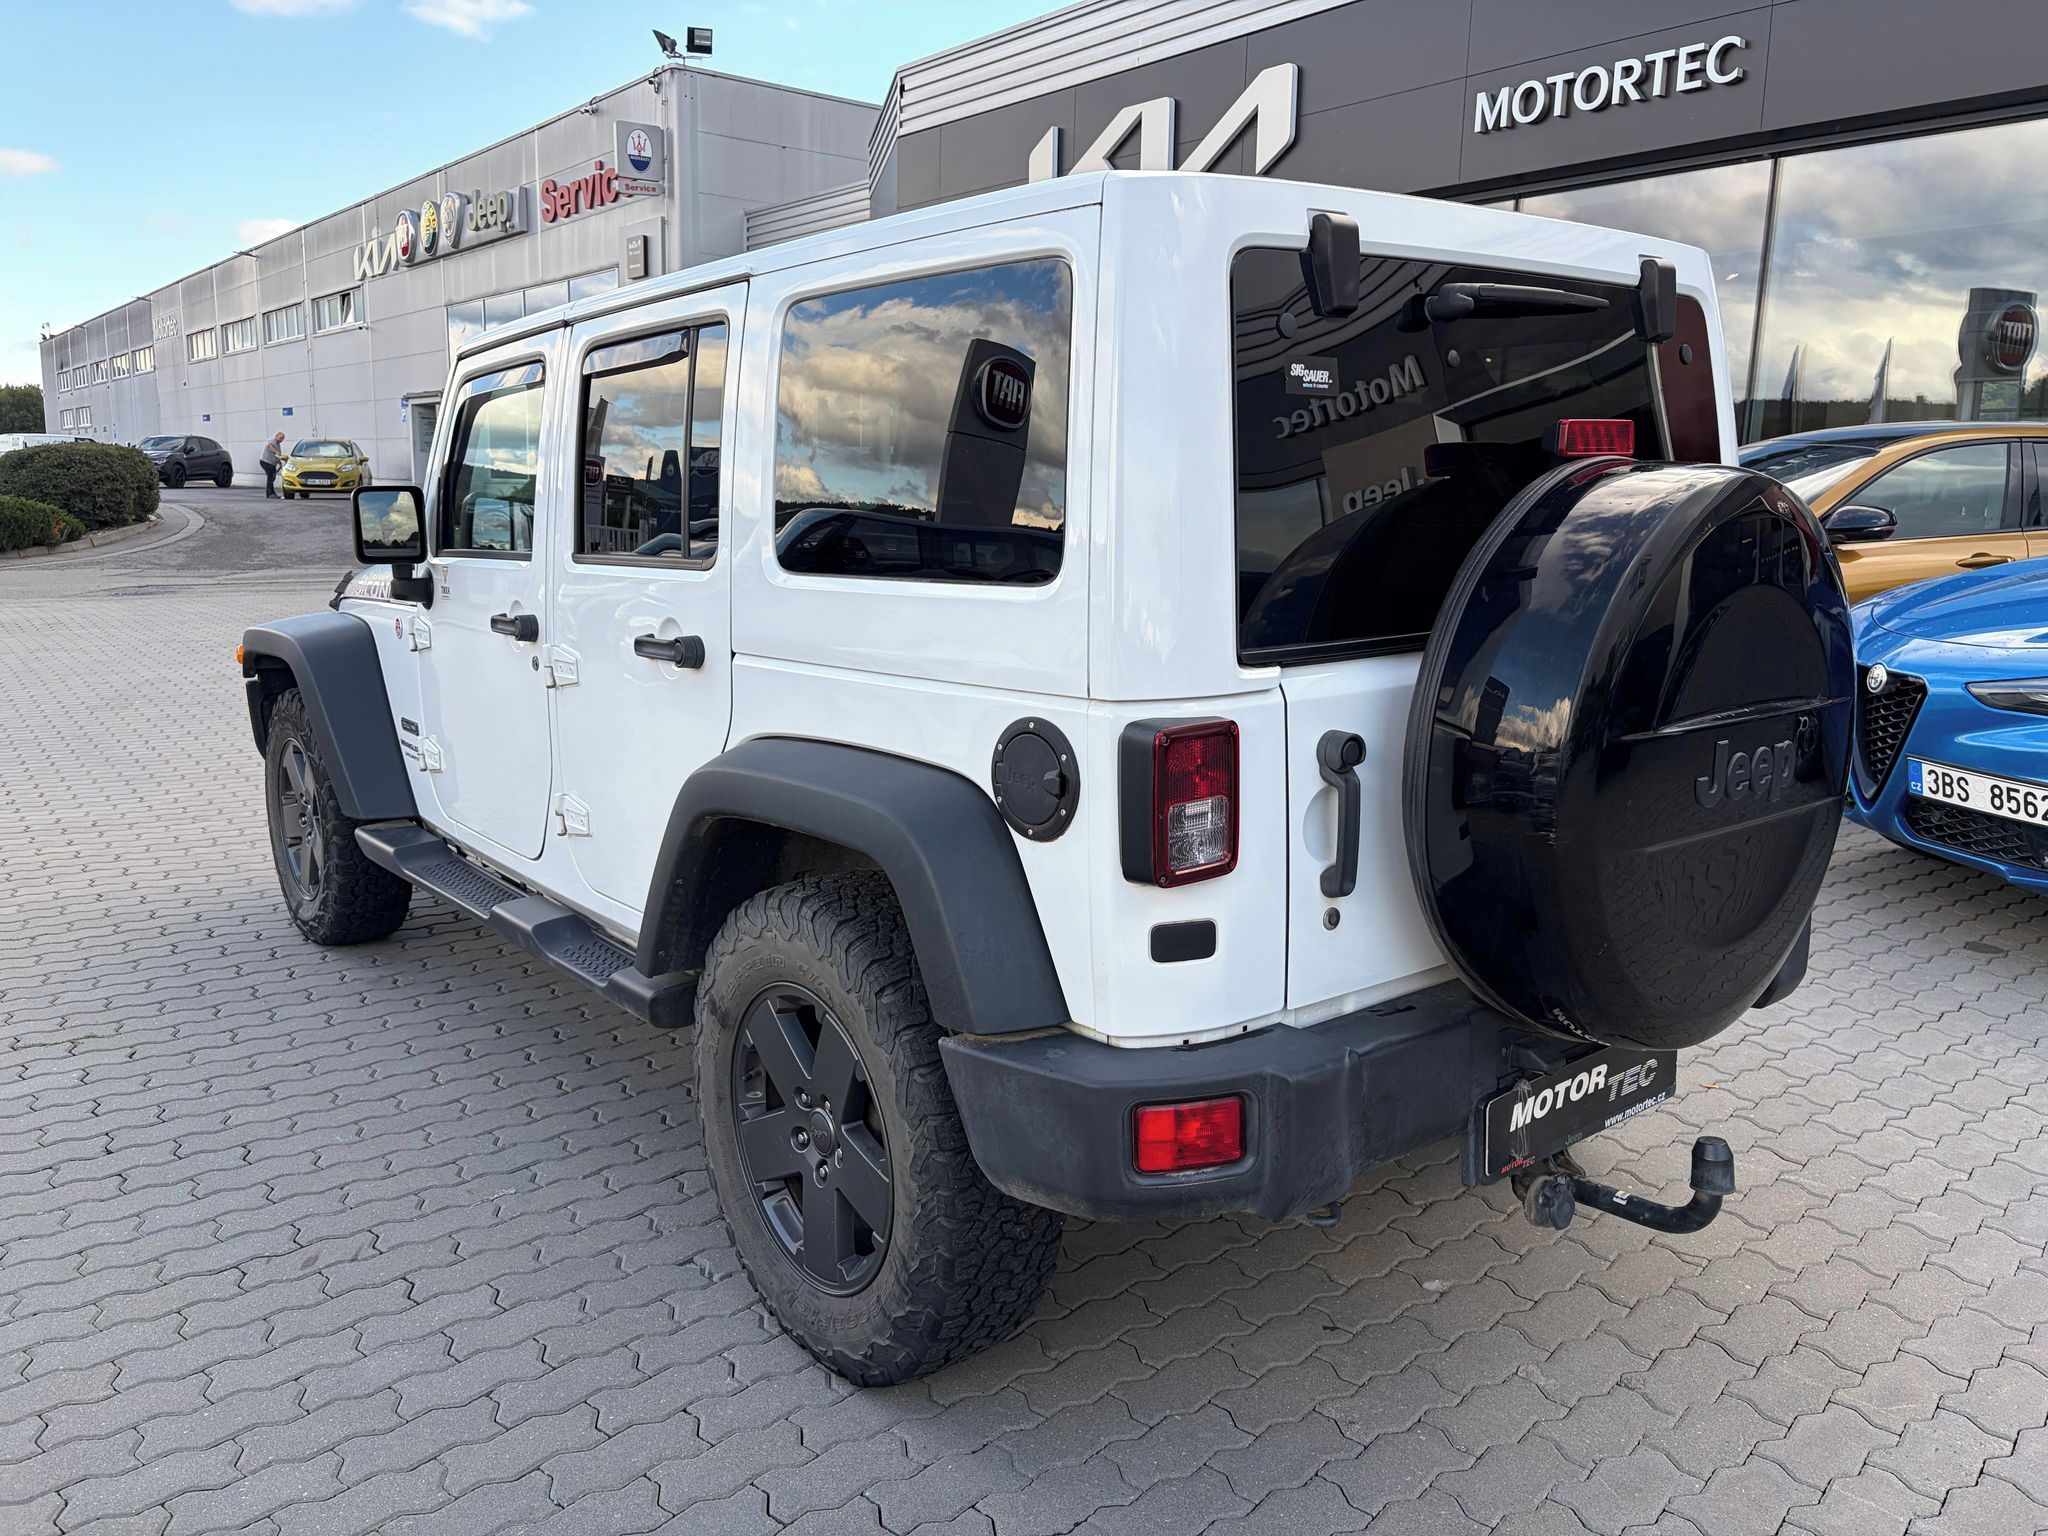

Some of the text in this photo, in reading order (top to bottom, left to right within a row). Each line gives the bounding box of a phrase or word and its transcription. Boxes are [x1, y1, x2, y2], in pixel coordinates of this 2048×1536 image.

[1474, 35, 1746, 134] MOTORTEC
[541, 160, 620, 223] Servic
[624, 183, 657, 193] Service
[466, 189, 513, 233] Jeep
[1290, 363, 1305, 377] SIG
[1003, 766, 1037, 793] Jeep
[1694, 739, 1798, 809] Jeep
[1910, 781, 1922, 792] CZ
[1927, 769, 1970, 803] 3BS
[1604, 1092, 1666, 1128] www.motortec.cz
[1565, 1131, 1583, 1146] Jeep
